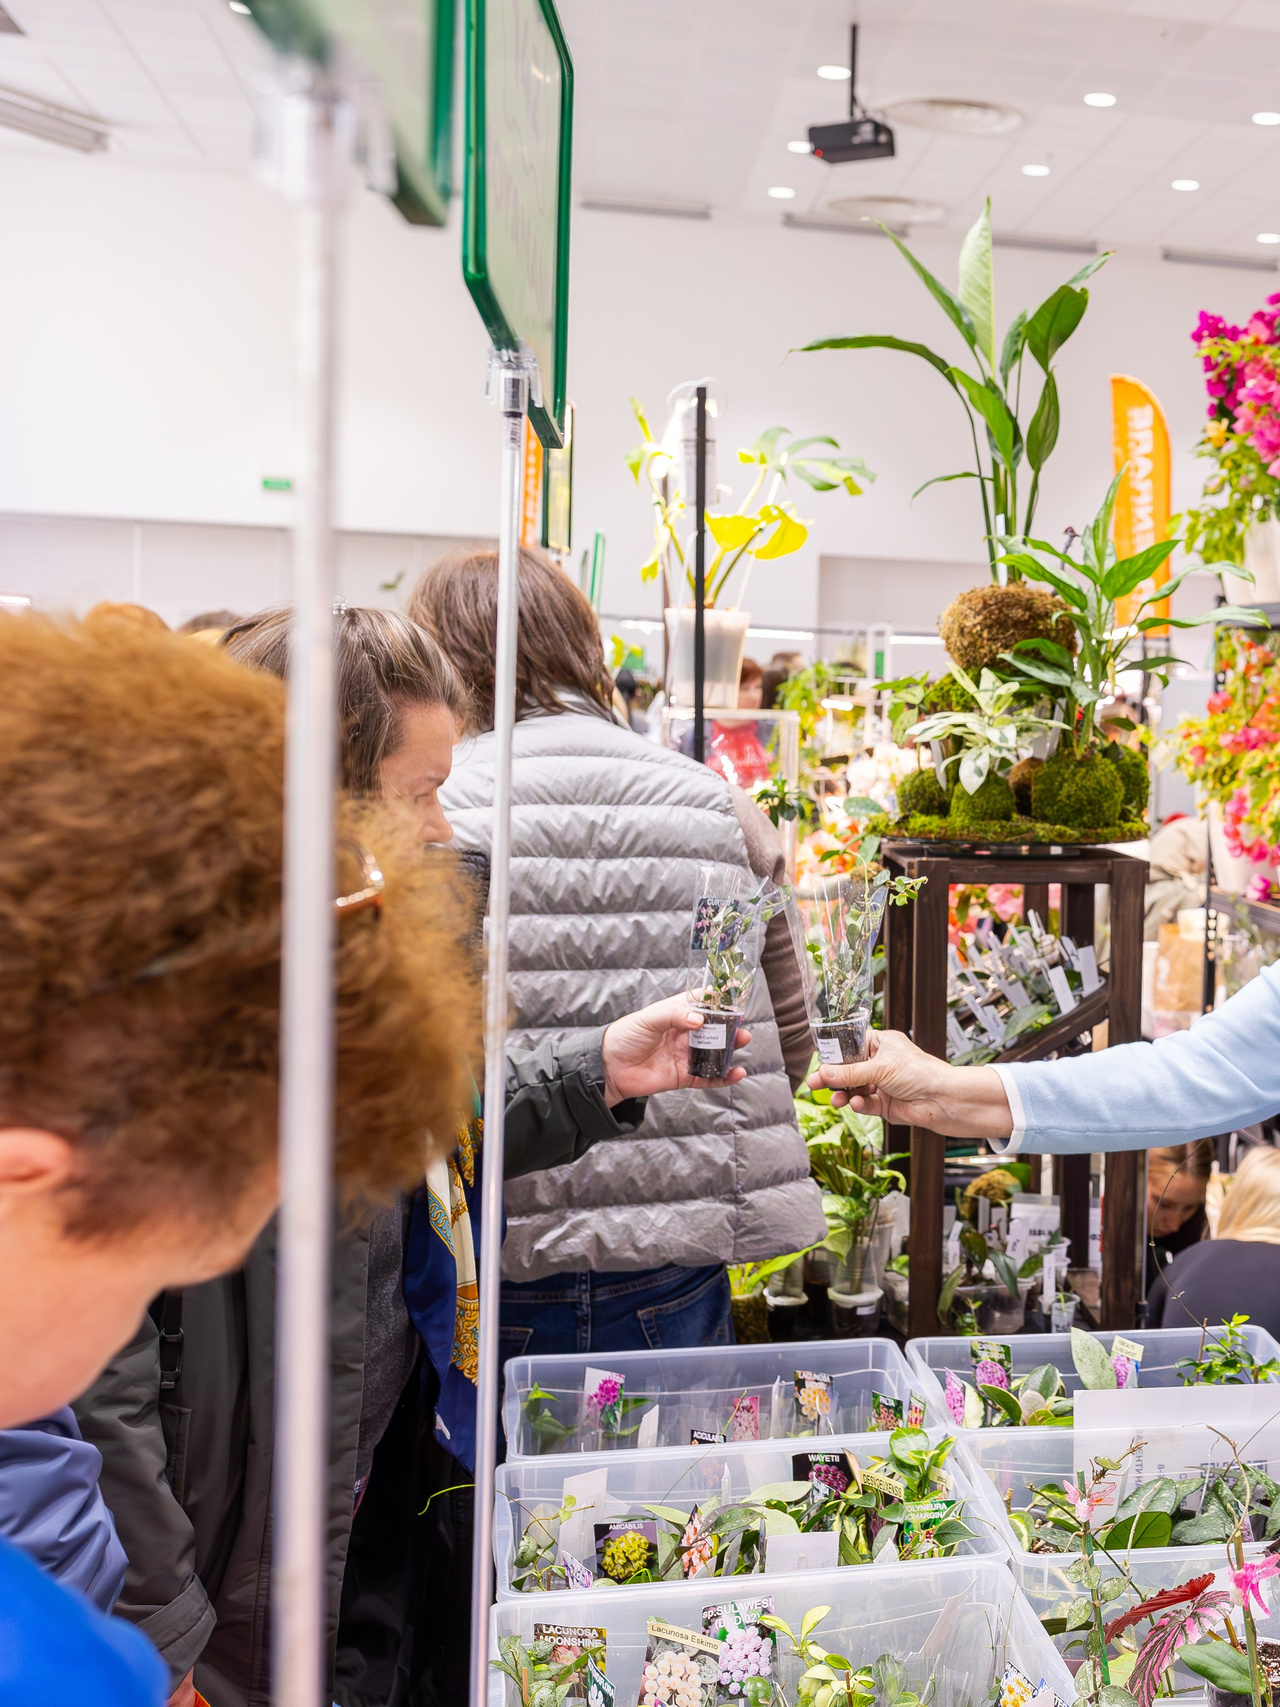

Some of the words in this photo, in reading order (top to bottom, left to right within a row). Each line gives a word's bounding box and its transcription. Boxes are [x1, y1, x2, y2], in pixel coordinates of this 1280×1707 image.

[808, 1454, 840, 1463] WAYETII
[904, 1502, 948, 1513] OLYNEURA
[608, 1522, 644, 1531] AMICABILIS
[542, 1624, 599, 1637] LACUNOSA
[651, 1624, 689, 1641] Lacunosa
[690, 1634, 719, 1650] Eskimo
